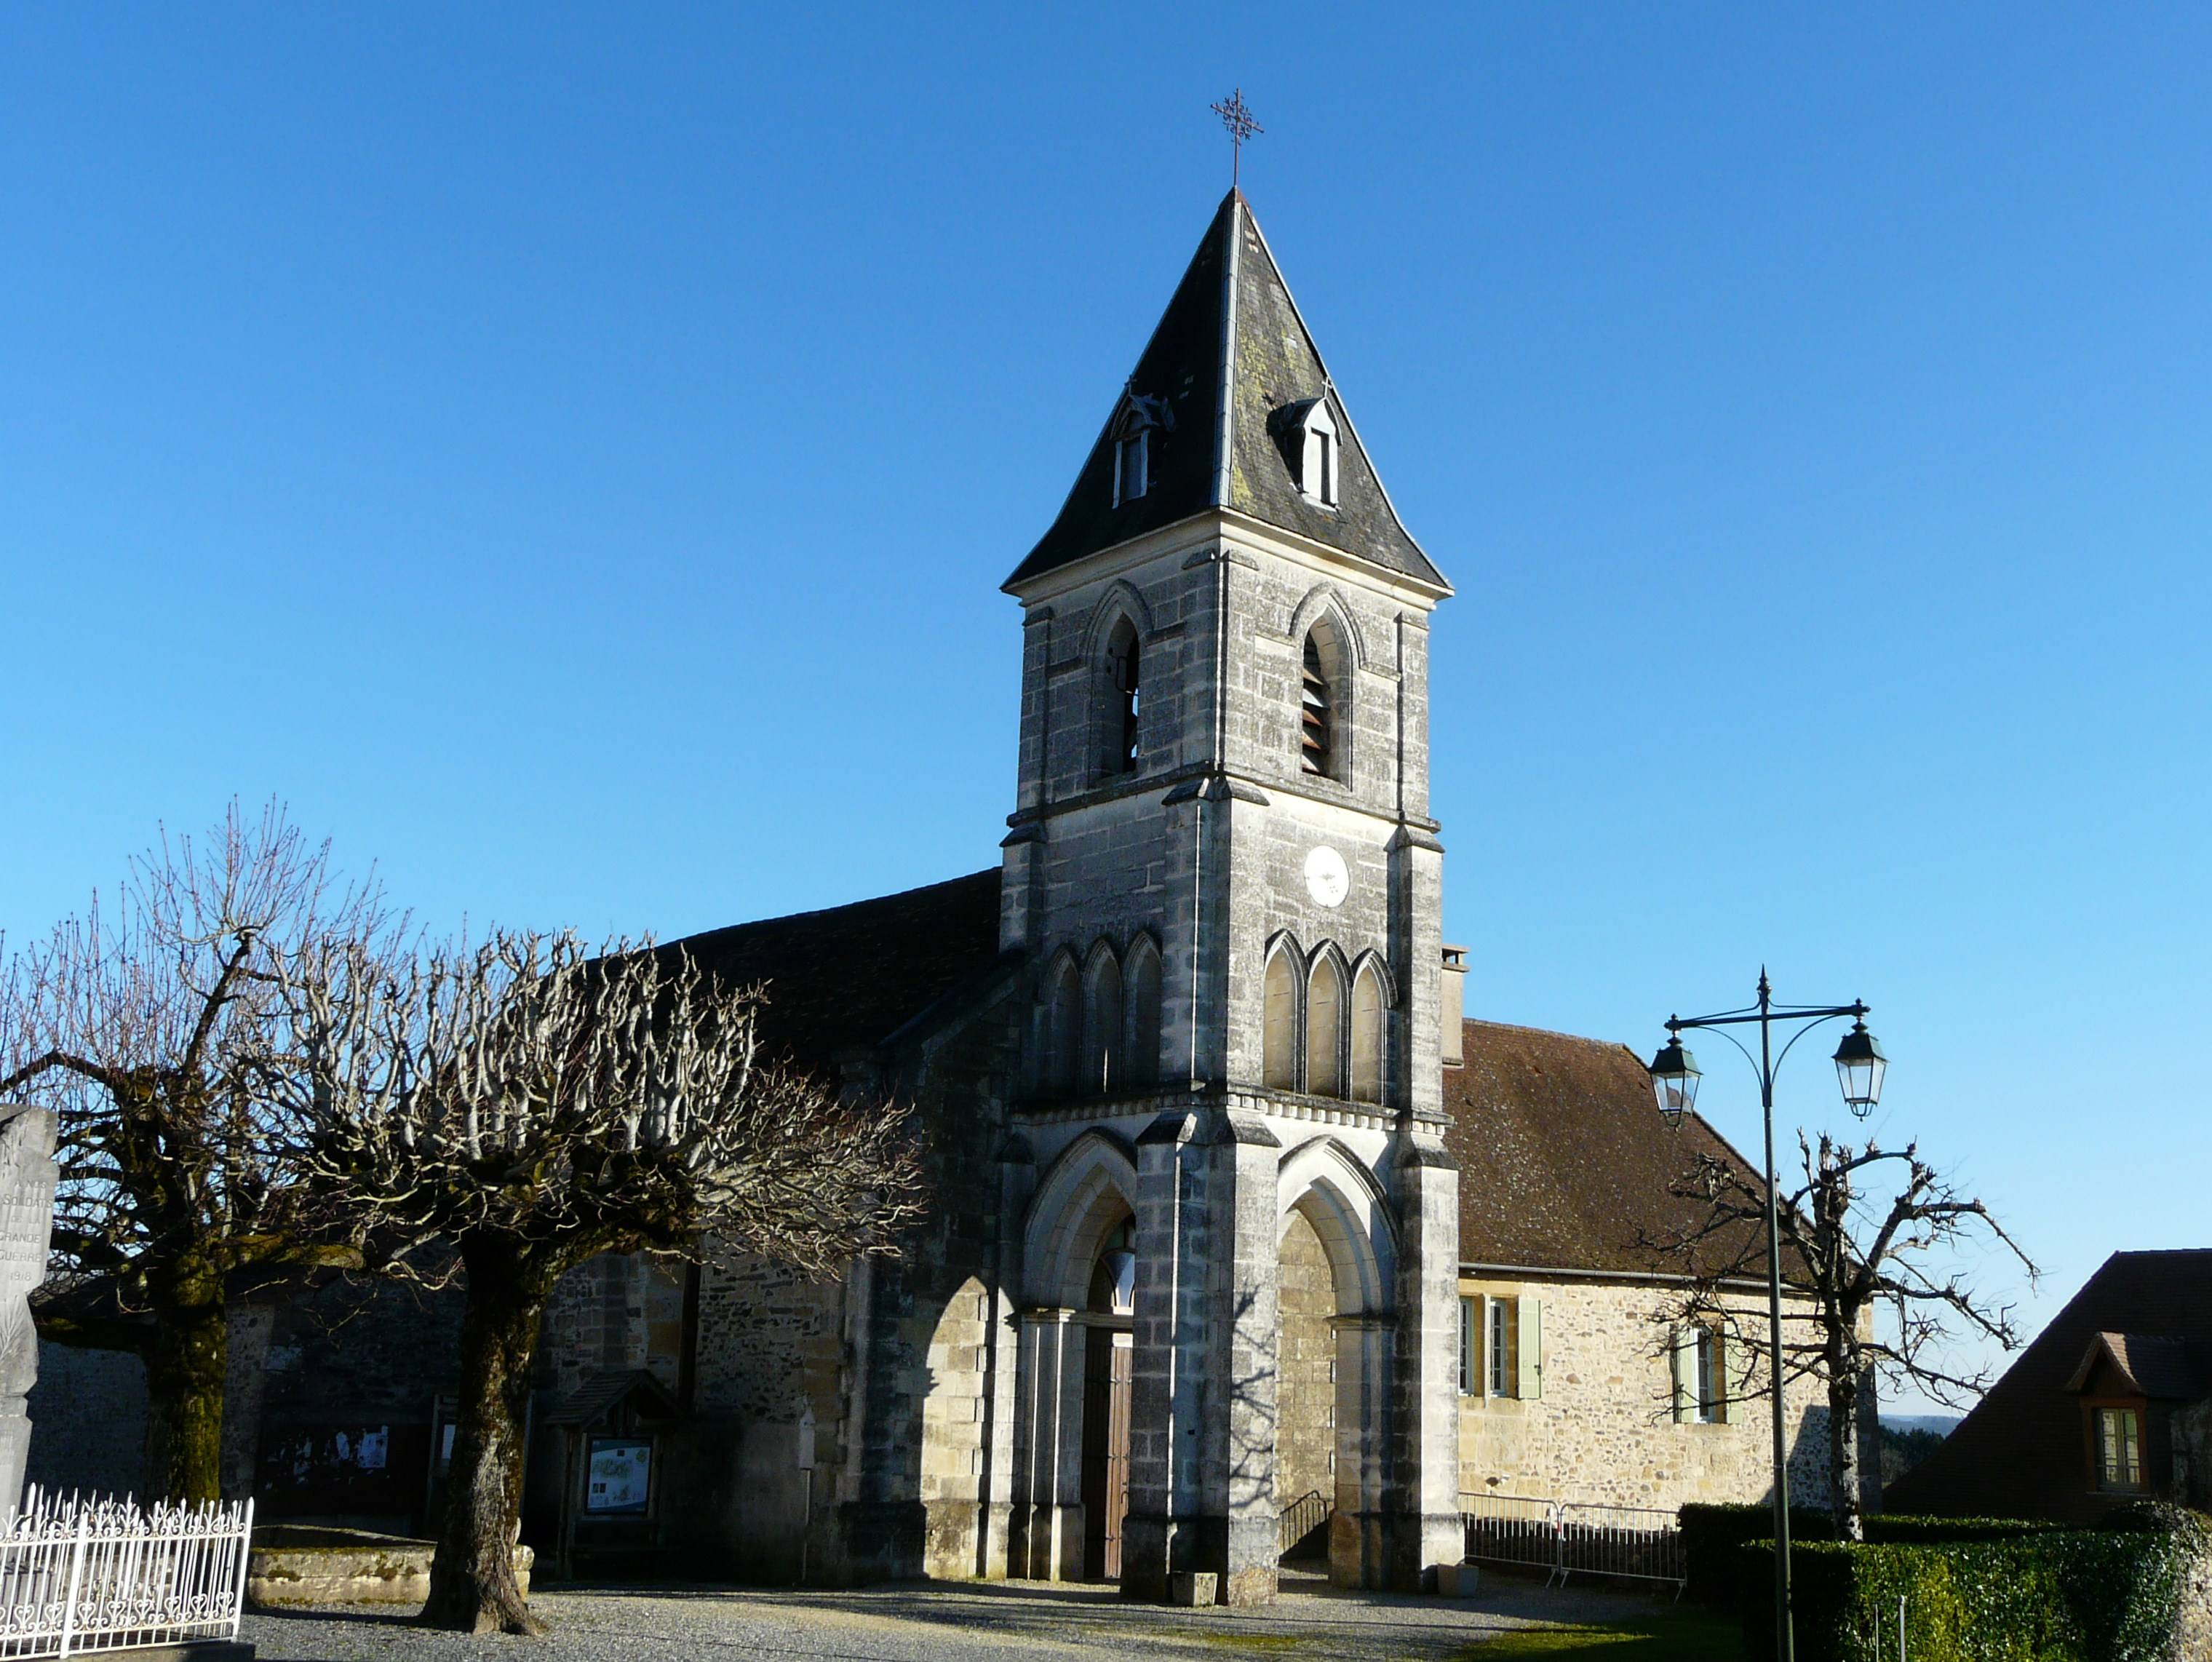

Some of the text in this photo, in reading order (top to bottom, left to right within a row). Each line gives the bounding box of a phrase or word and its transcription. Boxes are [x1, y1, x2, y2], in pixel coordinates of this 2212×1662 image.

[3, 1193, 53, 1209] SOLDATS
[0, 1230, 41, 1244] GRANDE
[0, 1249, 41, 1263] GUERRE
[10, 1271, 31, 1281] 1918
